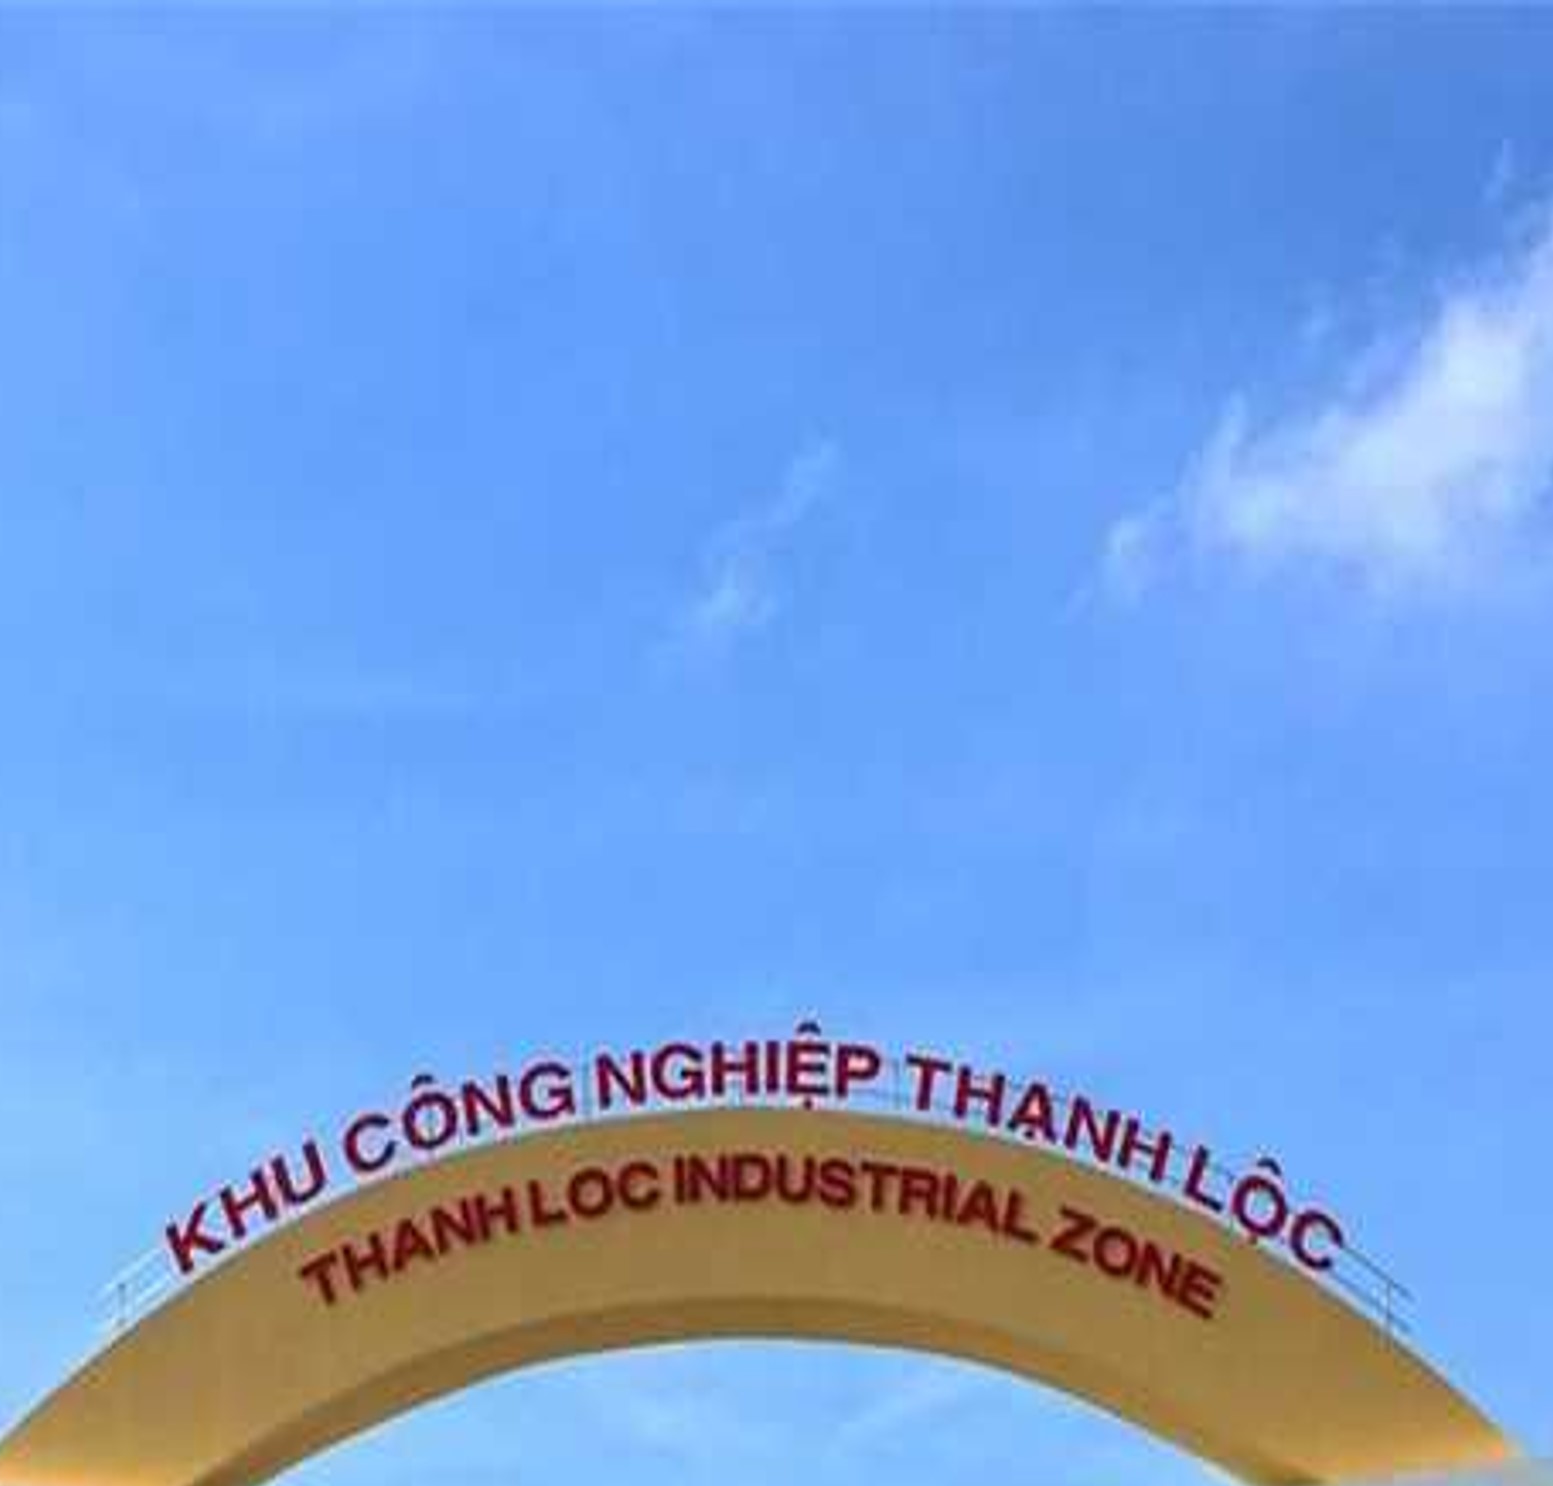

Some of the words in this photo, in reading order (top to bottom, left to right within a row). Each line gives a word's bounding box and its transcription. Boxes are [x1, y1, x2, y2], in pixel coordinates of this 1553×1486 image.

[164, 1141, 326, 1274] KHU
[344, 1063, 575, 1174] CÔNG
[597, 1021, 882, 1109] NGHIỆP
[906, 1055, 1174, 1183] THẠNH
[1183, 1145, 1345, 1271] LỘC
[299, 1187, 519, 1307] THANH
[527, 1160, 662, 1230] LOC
[674, 1153, 1039, 1244] INDUSTRIAL
[1049, 1207, 1225, 1320] ZONE
